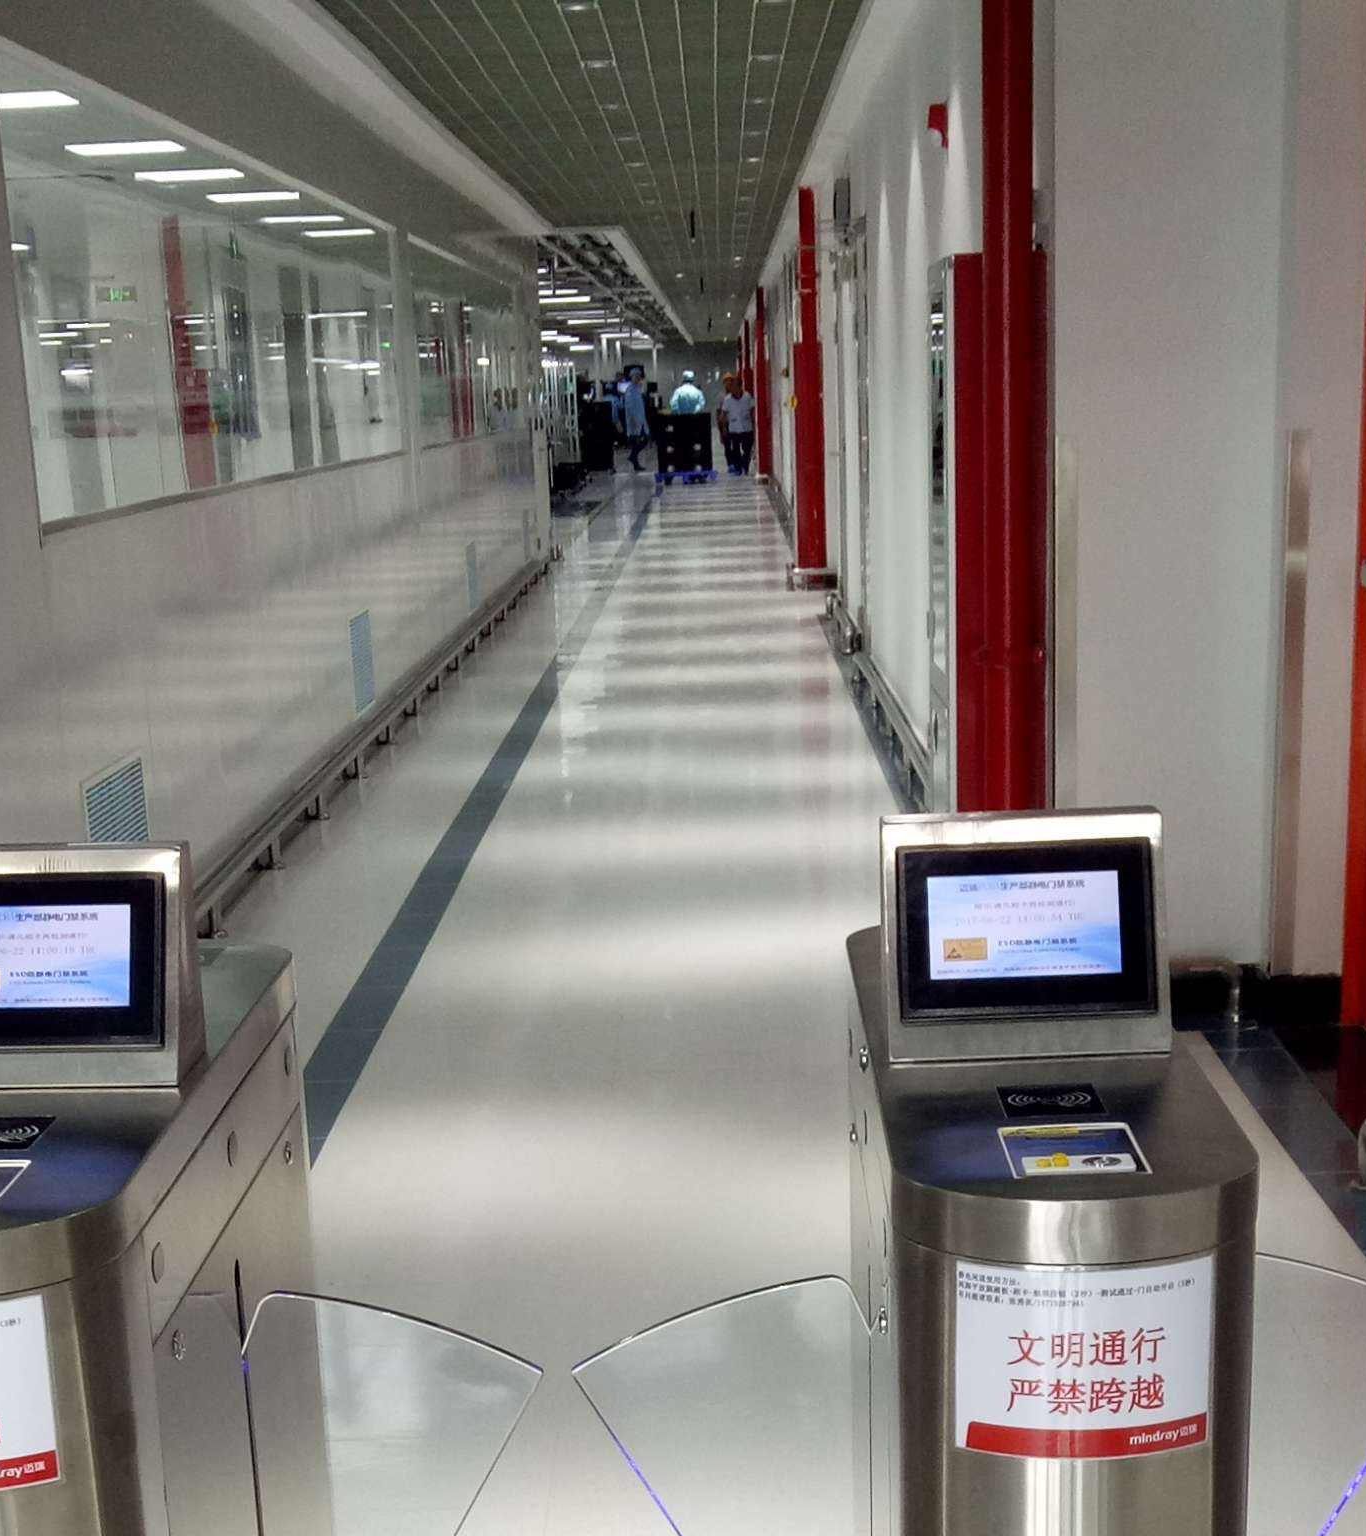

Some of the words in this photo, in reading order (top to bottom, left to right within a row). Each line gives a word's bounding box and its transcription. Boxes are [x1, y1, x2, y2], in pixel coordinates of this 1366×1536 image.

[1007, 1326, 1166, 1369] 文明通行
[1006, 1373, 1166, 1416] 严禁跨越
[1129, 1429, 1180, 1446] mindray
